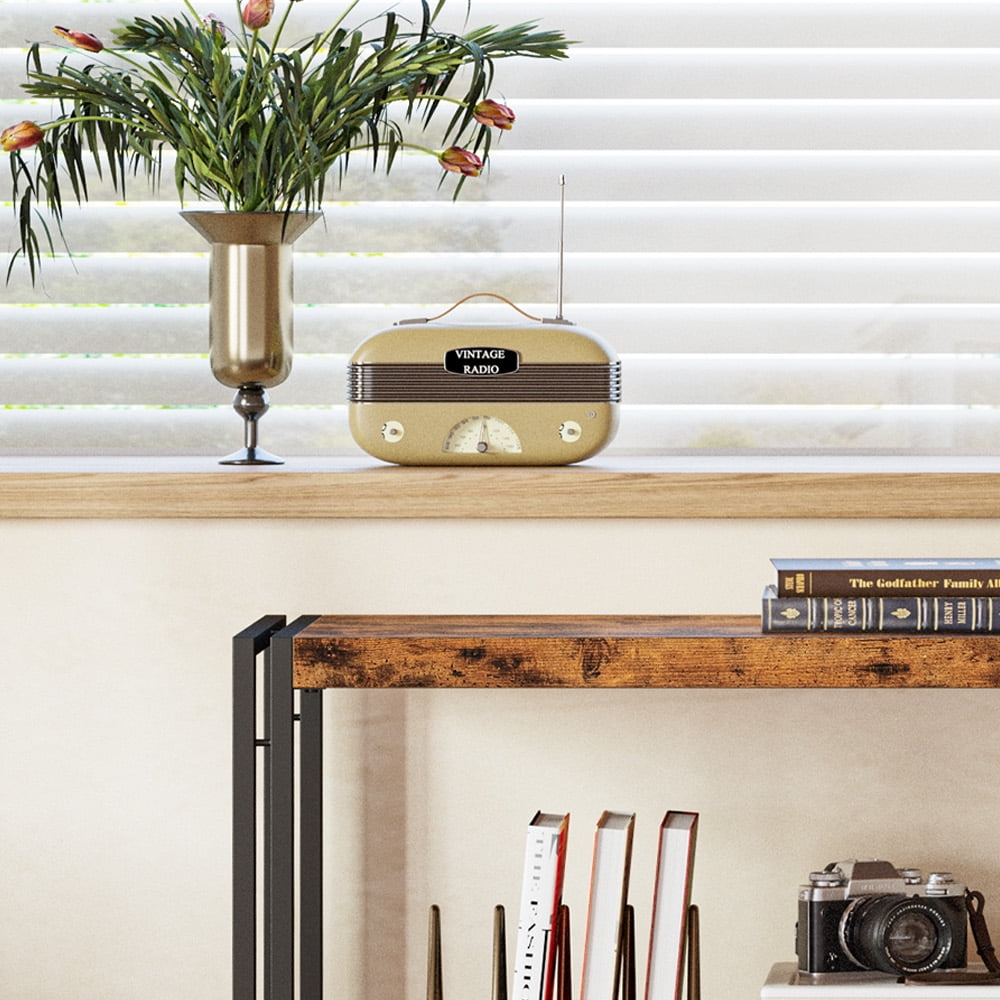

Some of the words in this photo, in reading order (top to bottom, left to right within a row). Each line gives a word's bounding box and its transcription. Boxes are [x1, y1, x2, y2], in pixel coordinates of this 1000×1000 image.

[455, 350, 506, 359] VINTAGE
[463, 365, 500, 374] RADIO
[848, 578, 873, 589] The
[876, 578, 940, 589] Godfather
[943, 578, 984, 590] Family
[943, 601, 954, 625] HENRY
[957, 601, 967, 625] MILLER
